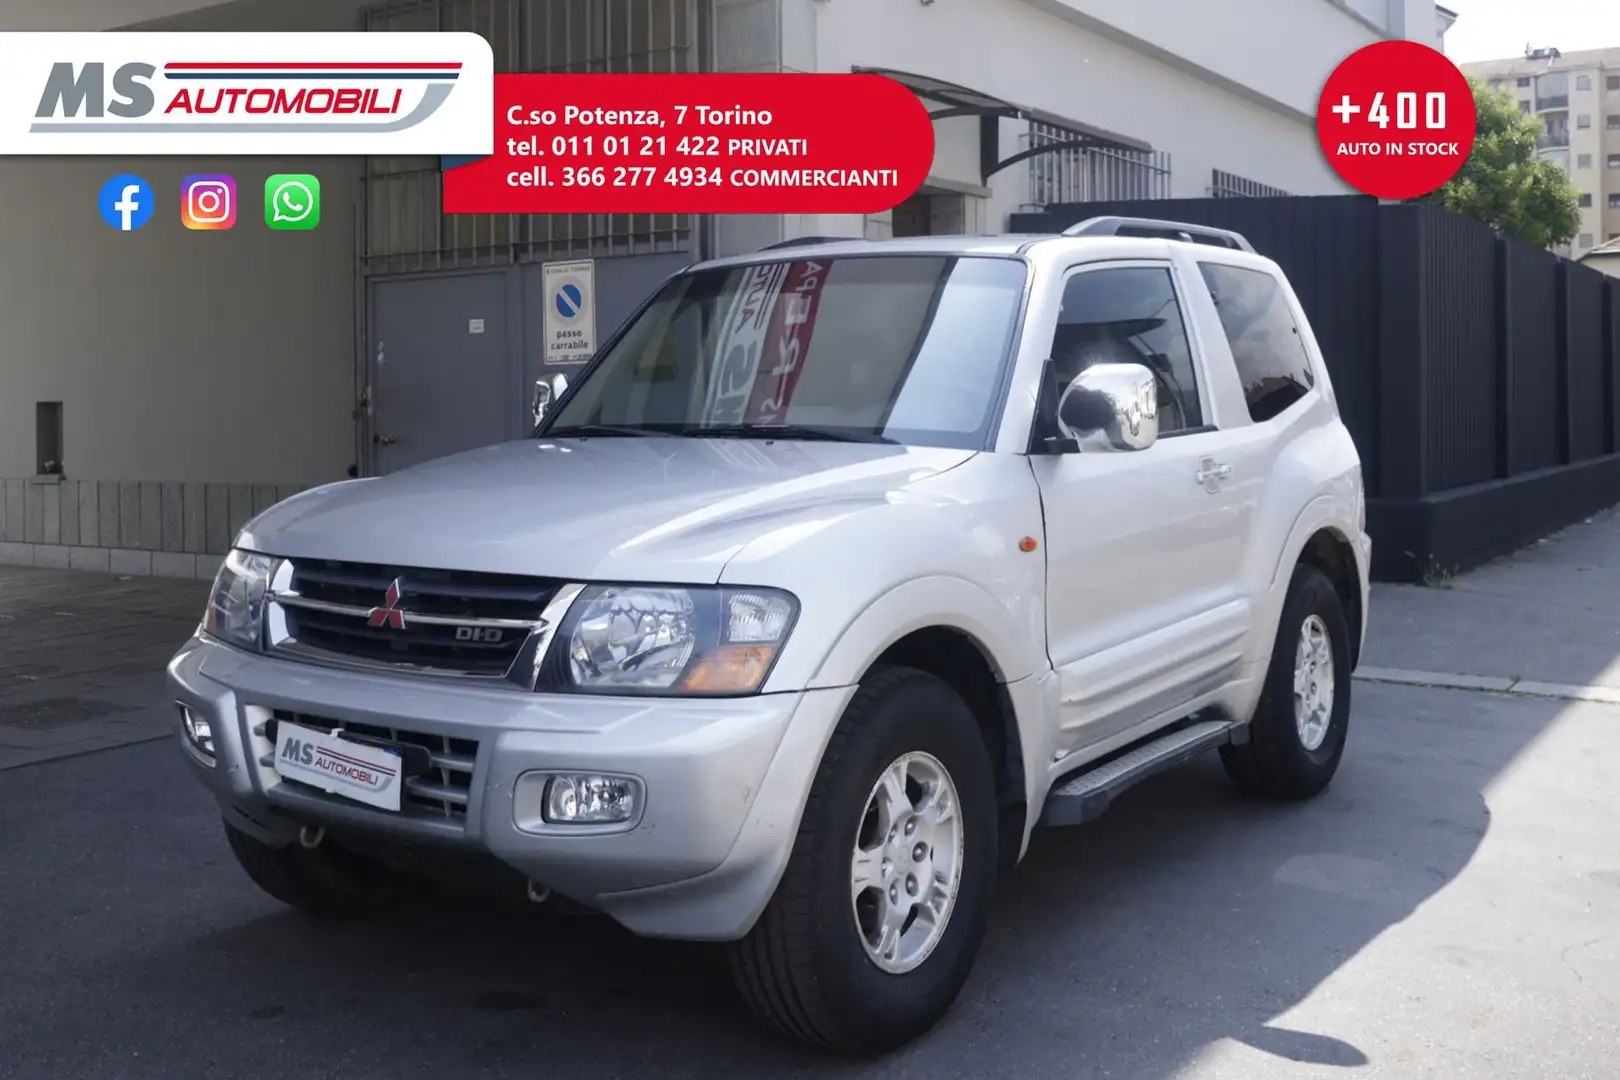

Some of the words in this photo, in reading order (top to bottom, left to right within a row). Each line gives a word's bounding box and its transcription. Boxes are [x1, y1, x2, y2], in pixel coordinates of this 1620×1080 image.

[556, 330, 582, 340] passo
[550, 341, 589, 350] carrabile
[281, 737, 314, 765] MS
[314, 757, 379, 786] AUTOMOBILI
